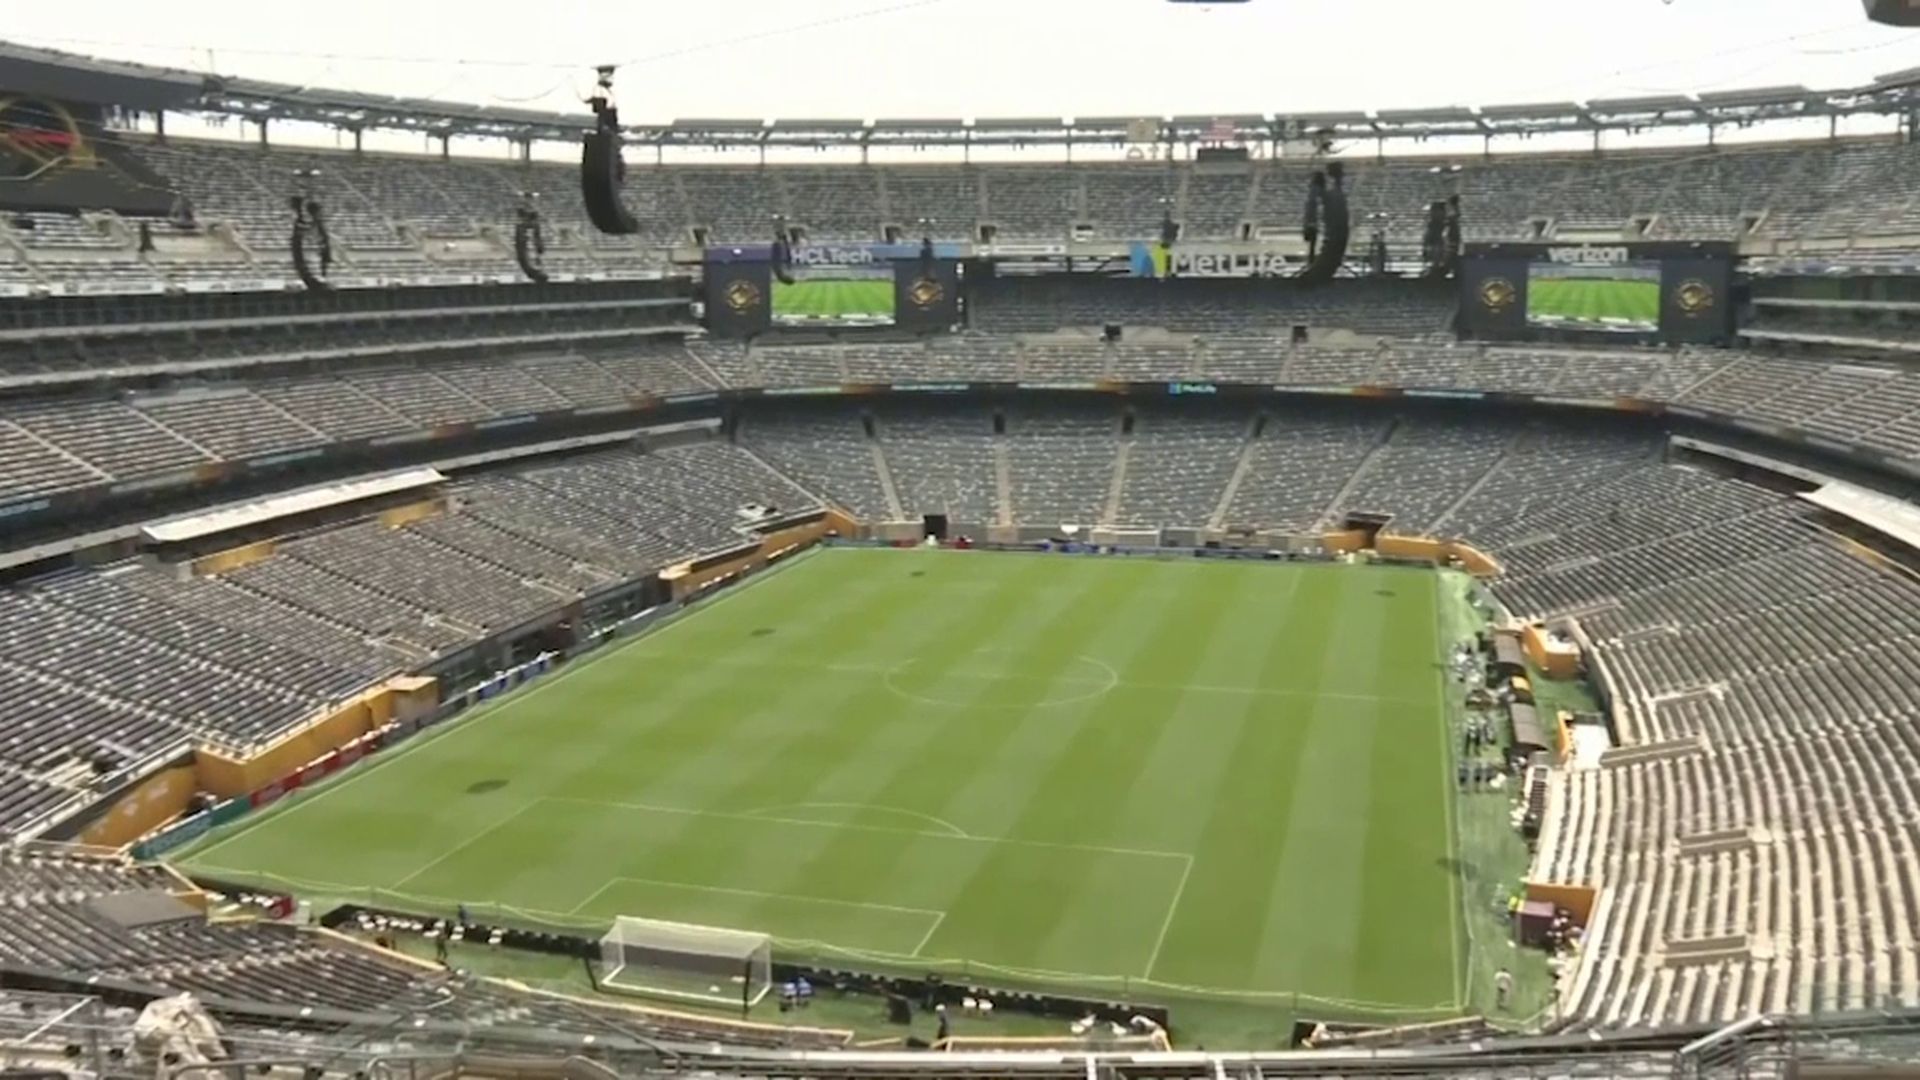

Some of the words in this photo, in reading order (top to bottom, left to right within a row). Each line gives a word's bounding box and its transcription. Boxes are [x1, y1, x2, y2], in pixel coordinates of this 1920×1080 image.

[790, 246, 873, 264] HCLTech
[1547, 243, 1629, 262] verizon
[1171, 250, 1287, 275] MetLife
